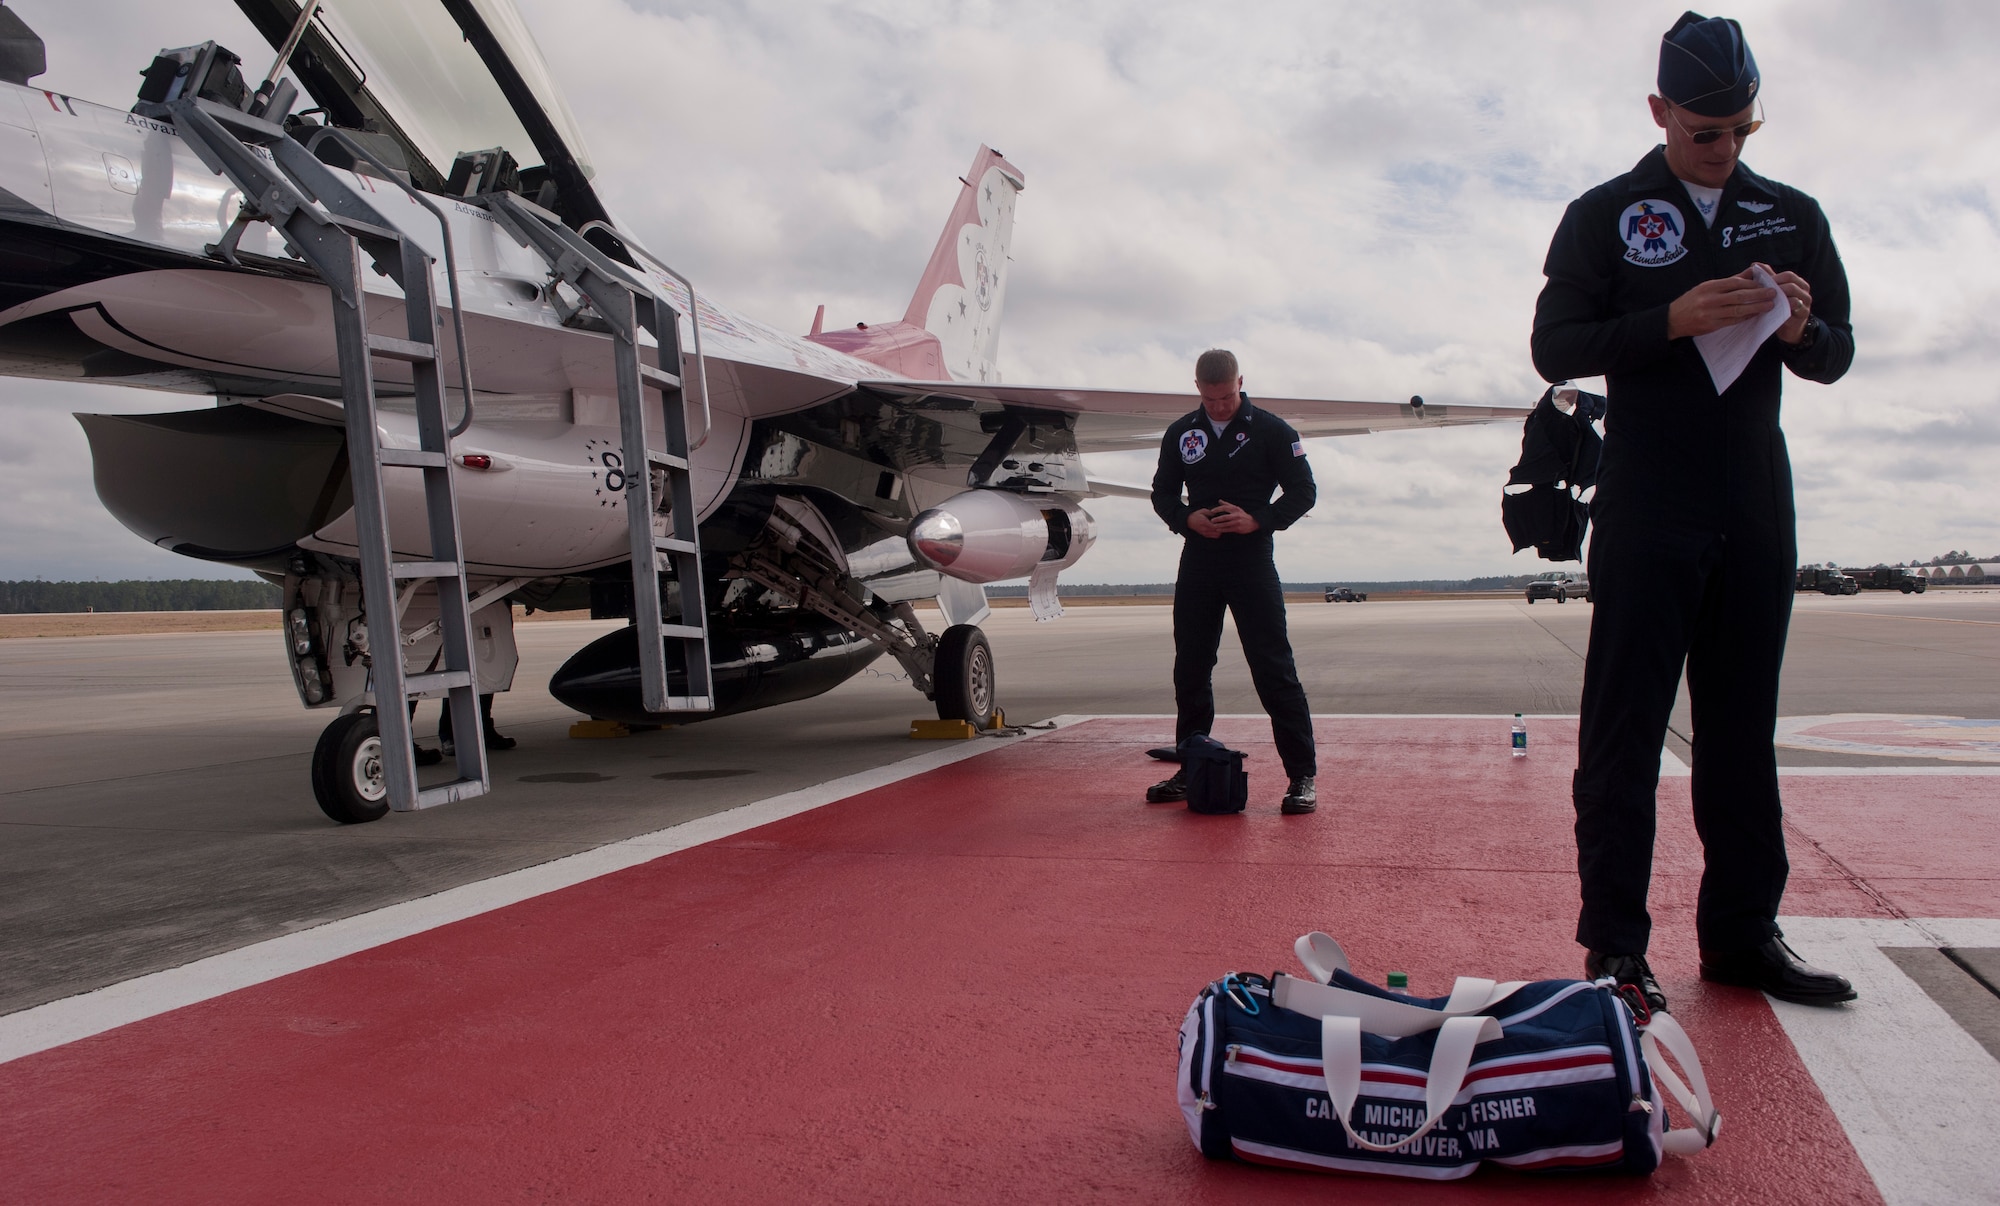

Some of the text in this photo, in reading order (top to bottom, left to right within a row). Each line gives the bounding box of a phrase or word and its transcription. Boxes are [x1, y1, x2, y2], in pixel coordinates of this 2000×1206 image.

[454, 202, 497, 223] Advanc
[1722, 226, 1734, 248] 8
[1626, 244, 1685, 265] Thunderbirds
[601, 451, 626, 492] 8
[1365, 1104, 1448, 1131] MICHAL
[1457, 1111, 1468, 1131] J
[1470, 1096, 1537, 1123] FISHER
[1467, 1128, 1500, 1150] WA
